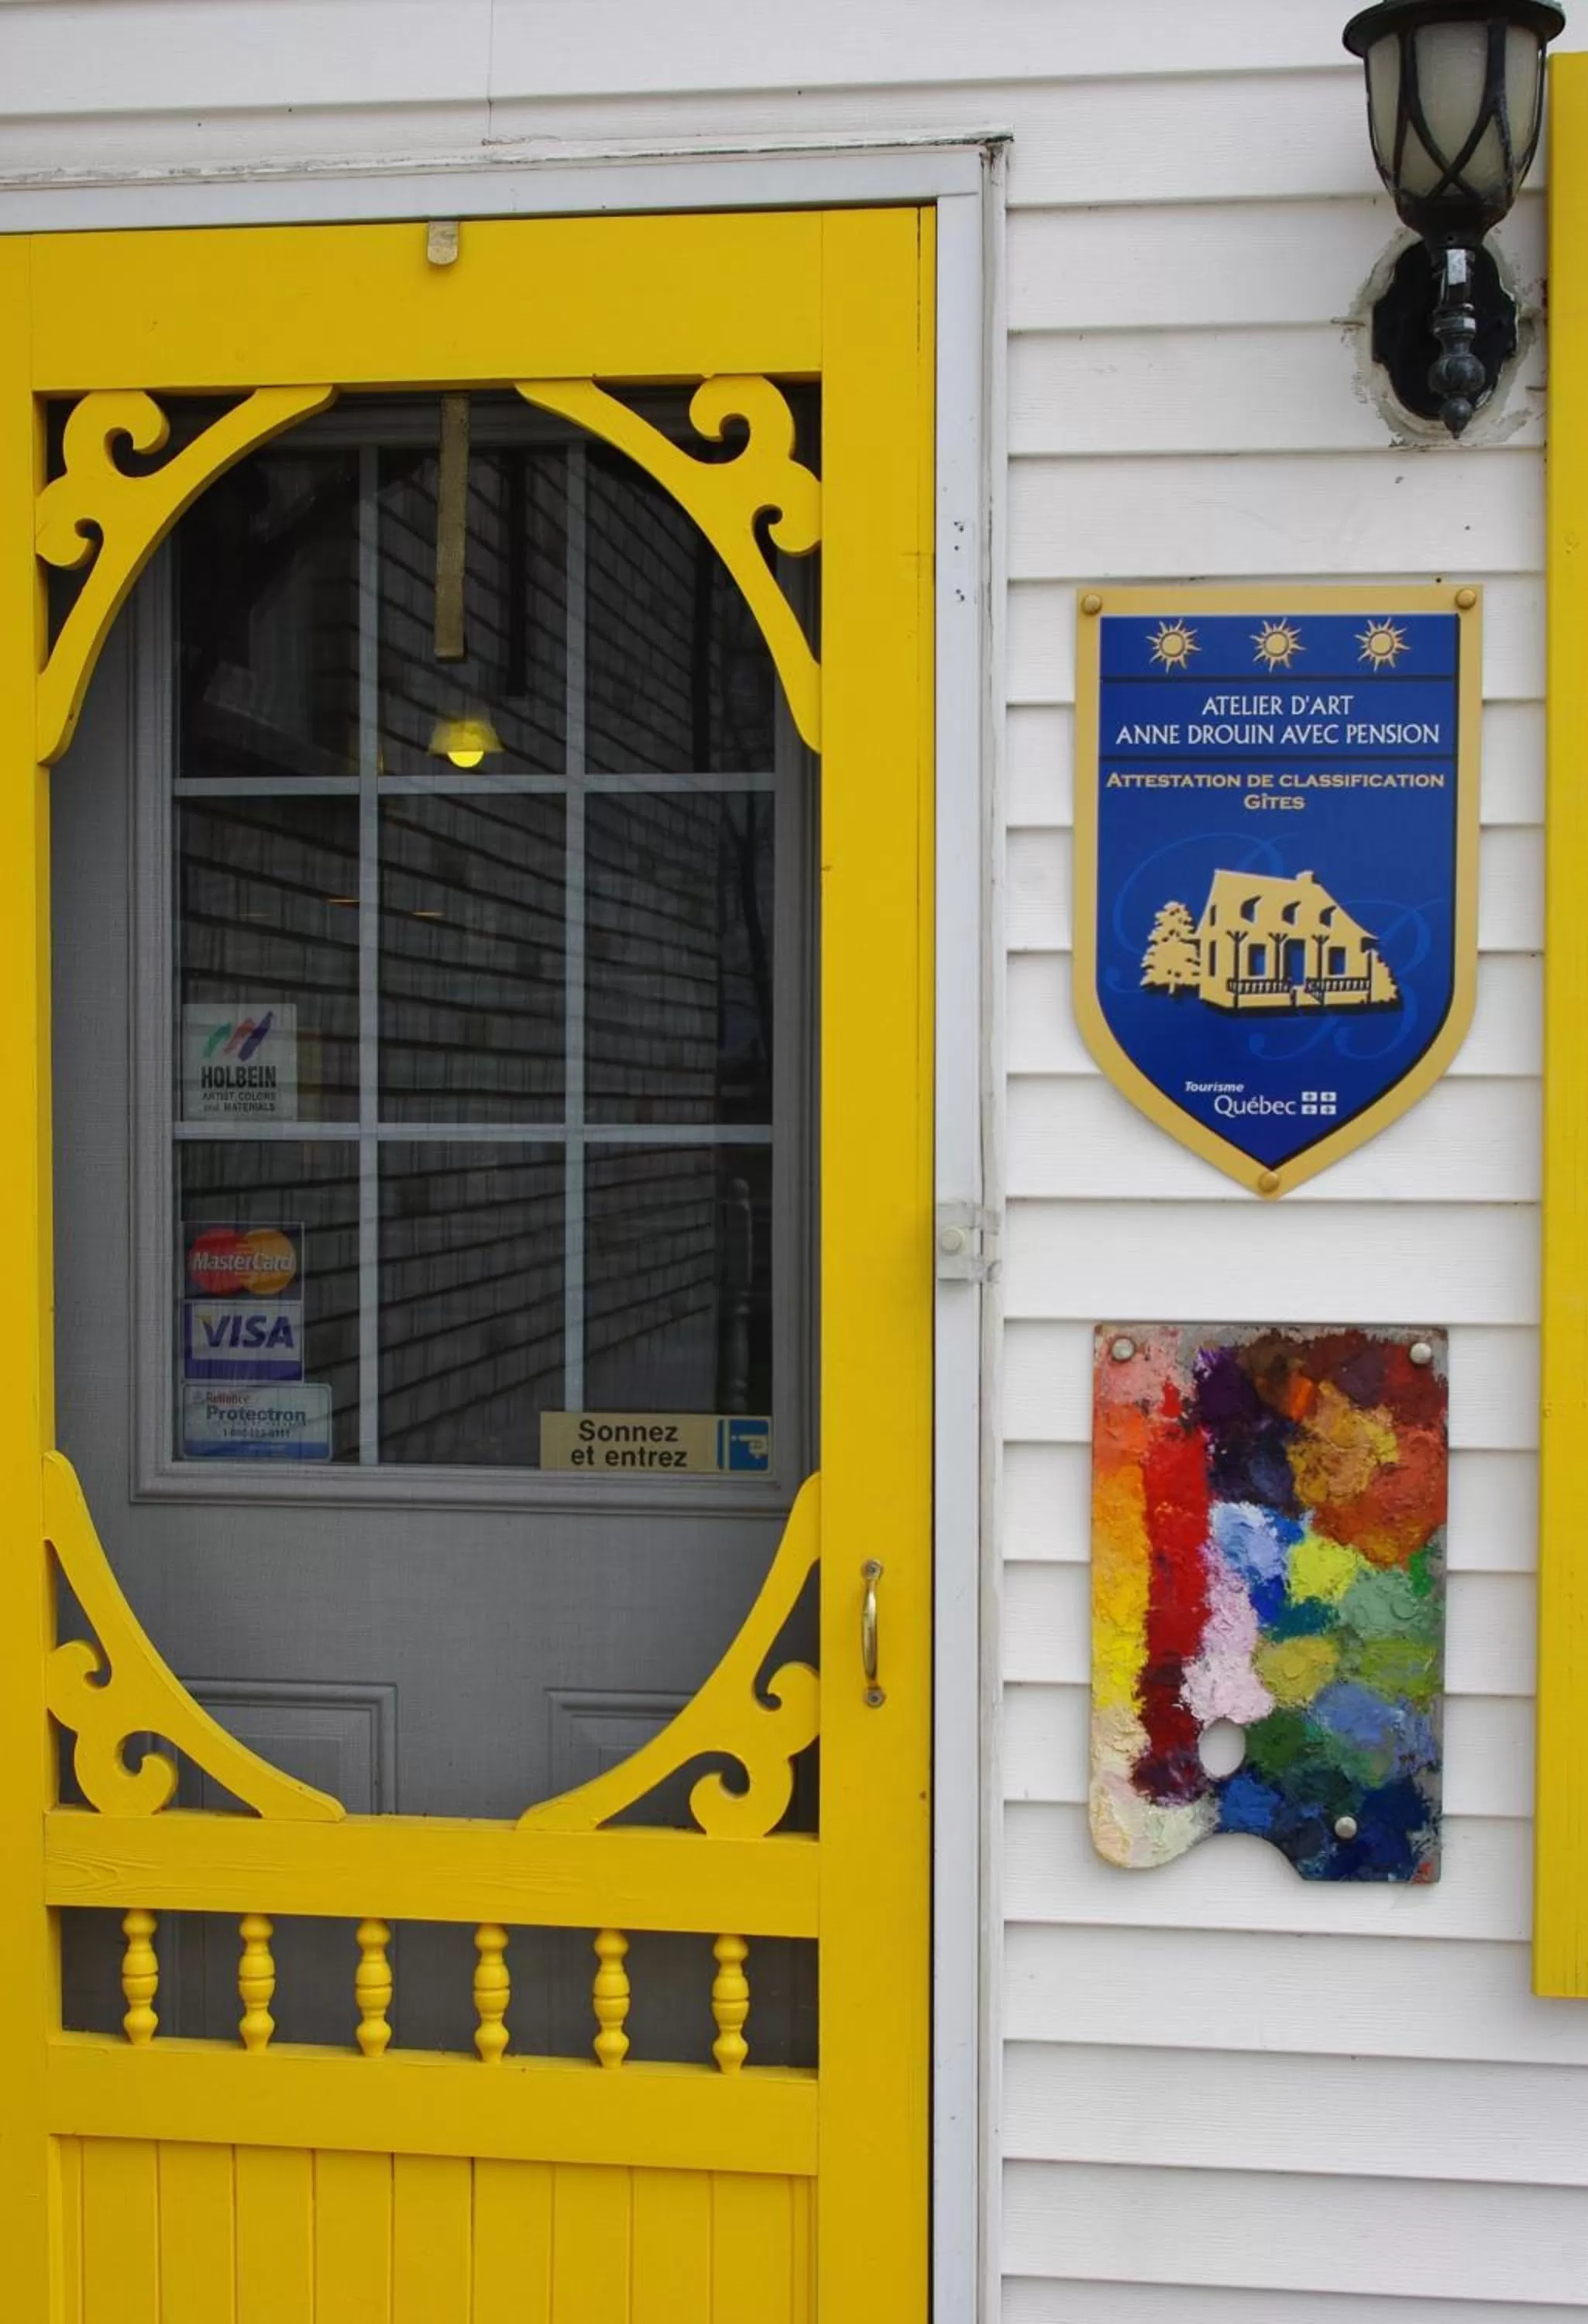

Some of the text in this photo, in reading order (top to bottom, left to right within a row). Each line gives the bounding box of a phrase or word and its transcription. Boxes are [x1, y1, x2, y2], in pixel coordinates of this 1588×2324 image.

[1201, 695, 1354, 716] ATELIER D'ART
[1115, 724, 1439, 744] ANNE DROUIN AVEC PENSION
[1106, 772, 1445, 788] ATTESTATION DE CLASSIFICATION
[201, 1065, 277, 1088] HOLBEIN
[1184, 1081, 1245, 1092] Tourisme
[1214, 1094, 1297, 1118] Québec
[193, 1251, 294, 1271] MasterCard
[199, 1314, 294, 1349] VISA
[206, 1405, 306, 1423] Protectron
[579, 1418, 679, 1442] Sonnez
[570, 1447, 688, 1467] et entrez
